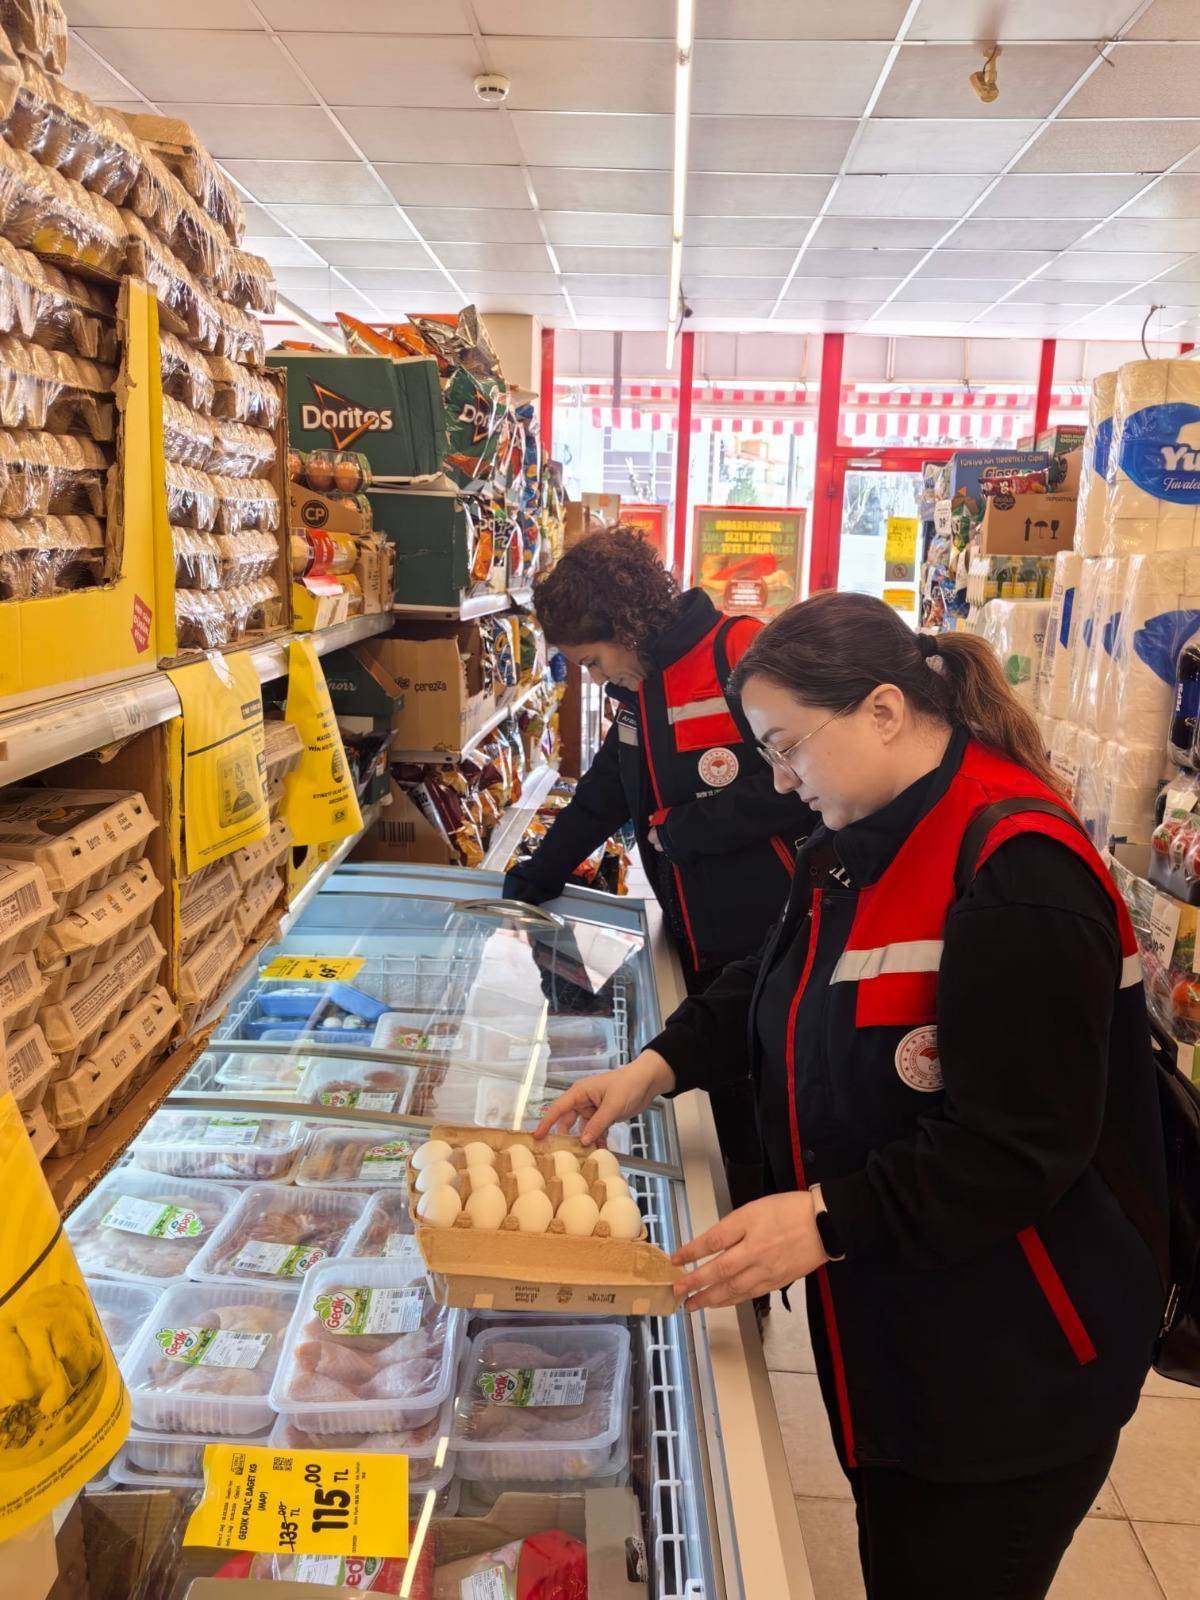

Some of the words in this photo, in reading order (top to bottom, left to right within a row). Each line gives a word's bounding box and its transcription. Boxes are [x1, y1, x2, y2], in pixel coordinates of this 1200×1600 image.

[302, 405, 393, 430] Doritos
[305, 508, 325, 520] CP
[1176, 683, 1184, 712] PEPSI
[327, 1296, 347, 1329] Gedik
[164, 1330, 190, 1356] Gedik
[490, 1374, 509, 1401] Gedik
[249, 1463, 257, 1474] KG
[333, 1468, 349, 1483] TL
[247, 1475, 257, 1497] BAGET
[257, 1491, 268, 1512] (MAP)
[290, 1507, 300, 1517] TL
